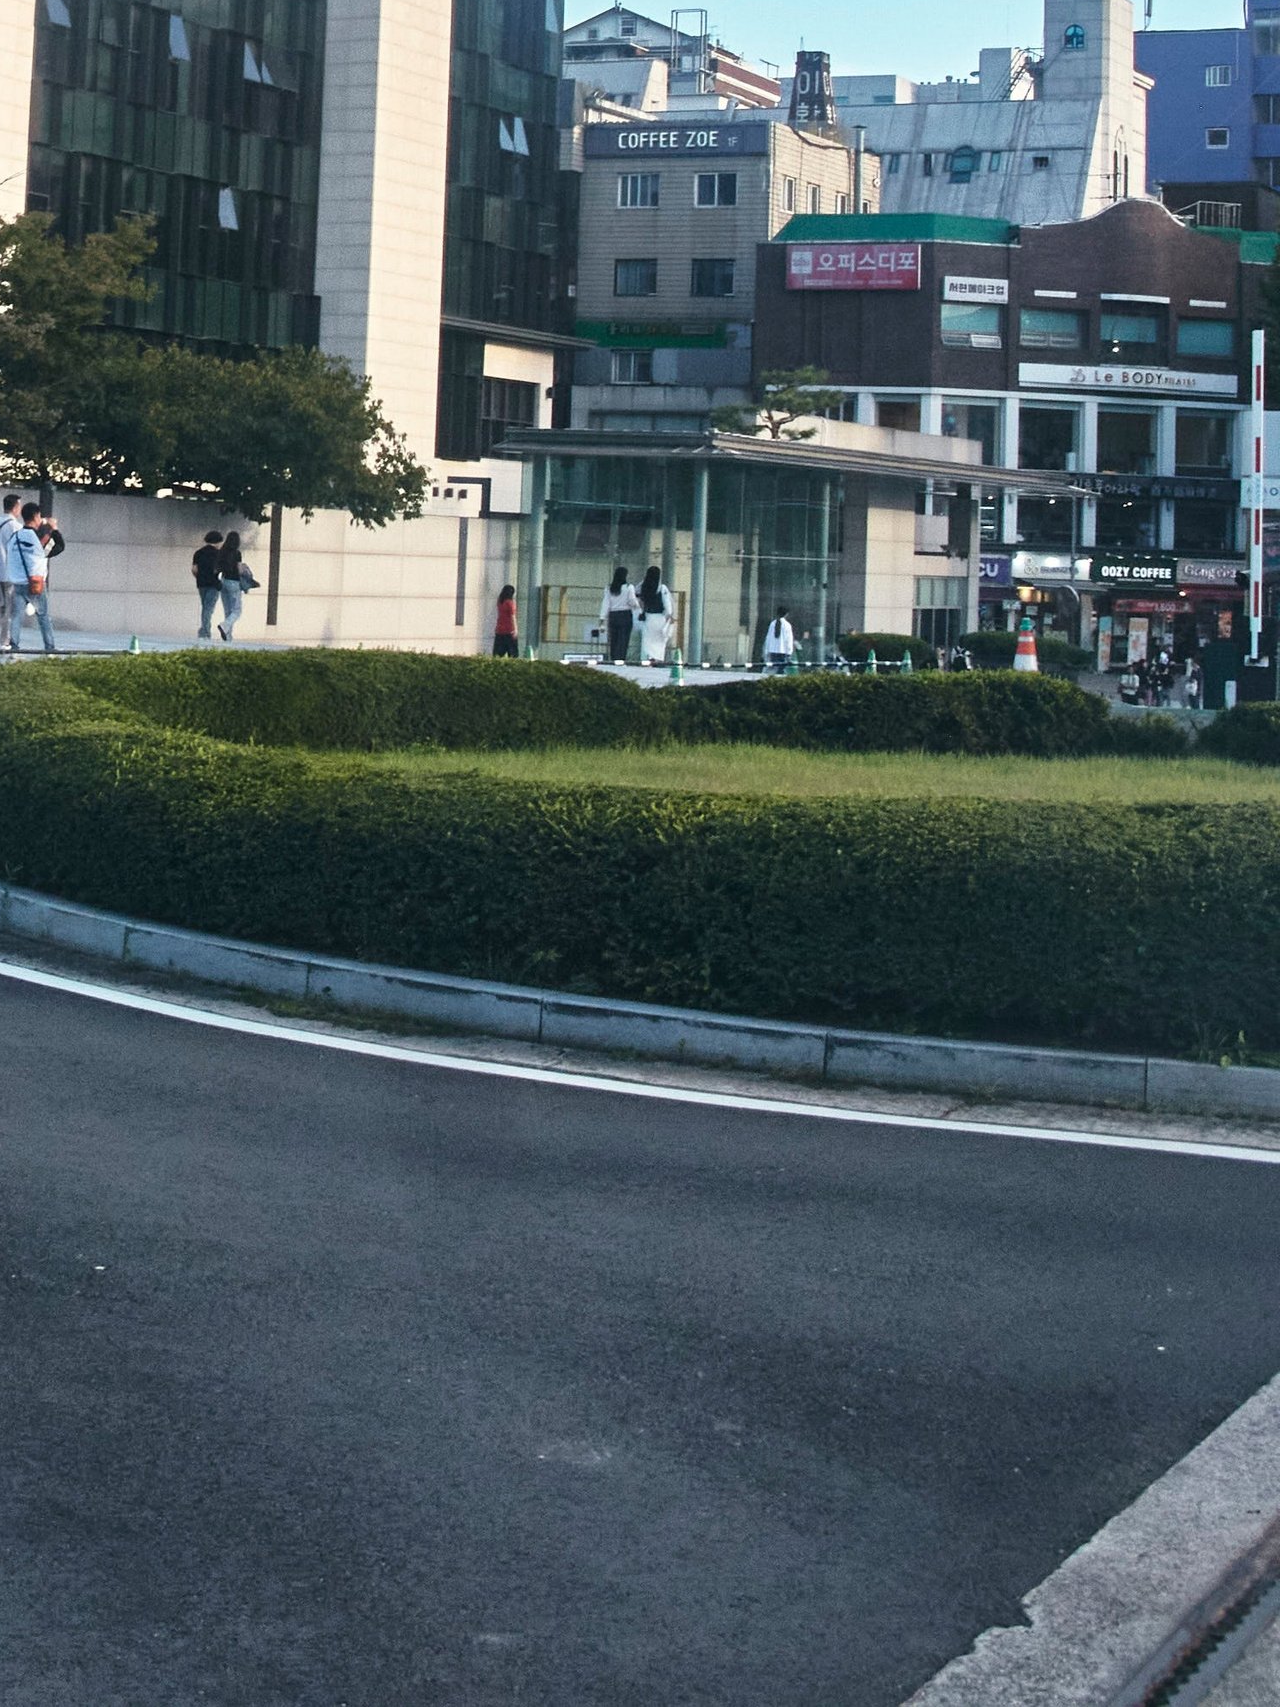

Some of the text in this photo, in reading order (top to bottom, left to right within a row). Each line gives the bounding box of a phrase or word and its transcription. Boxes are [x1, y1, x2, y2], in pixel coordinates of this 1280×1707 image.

[618, 131, 738, 148] COFFEE ZOE 1F
[816, 252, 917, 273] 오피스디포
[1094, 370, 1113, 382] Le
[1122, 371, 1162, 385] BODY
[1132, 567, 1172, 579] COFFEE
